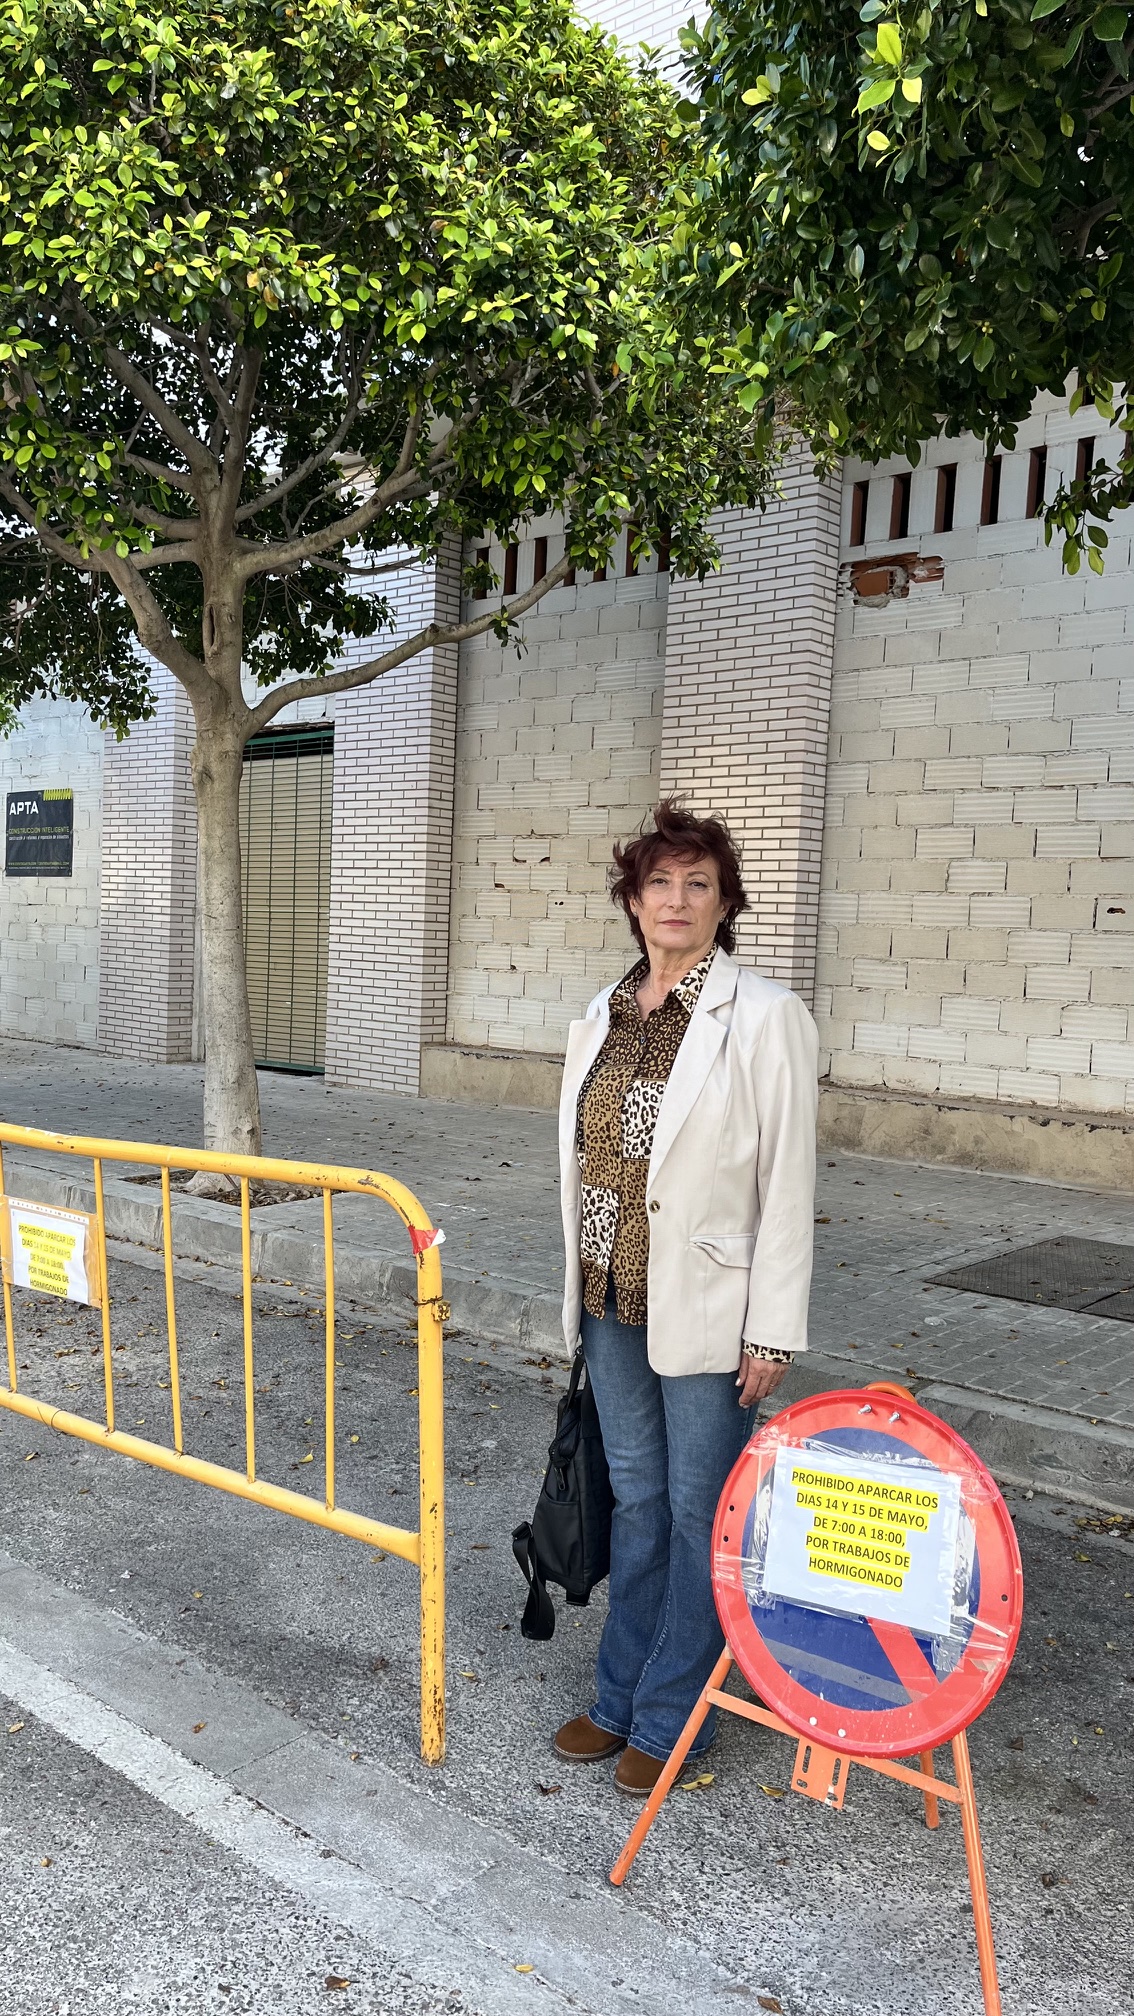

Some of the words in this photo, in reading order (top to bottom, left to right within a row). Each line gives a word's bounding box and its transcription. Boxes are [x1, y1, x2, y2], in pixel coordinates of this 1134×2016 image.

[9, 801, 39, 815] APTA
[18, 1224, 44, 1237] PROHIBIDO
[45, 1231, 66, 1243] APARCAR
[66, 1237, 76, 1247] LOS
[21, 1238, 33, 1247] DIAS
[43, 1244, 49, 1252] 15
[49, 1245, 55, 1254] DE
[30, 1252, 36, 1261] DE
[36, 1254, 46, 1265] 7:00
[28, 1265, 37, 1275] POR
[37, 1268, 61, 1282] TRABAJOS
[62, 1275, 70, 1284] DE
[29, 1278, 68, 1296] HORMIGONADO
[791, 1471, 854, 1492] PROHIBIDO
[857, 1483, 912, 1504] APARCAR
[915, 1494, 938, 1509] LOS
[796, 1492, 822, 1507] DIAS
[825, 1498, 838, 1510] 14
[841, 1501, 849, 1512] Y
[852, 1503, 865, 1516] 15
[868, 1507, 884, 1520] DE
[887, 1510, 928, 1530] MAYO,
[813, 1516, 828, 1529] DE
[831, 1519, 856, 1535] 7:00
[858, 1526, 867, 1537] A
[870, 1528, 905, 1547] 18:00,
[805, 1535, 829, 1550] POR
[832, 1540, 891, 1564] TRABAJOS
[894, 1554, 910, 1568] DE
[808, 1556, 903, 1588] HORMIGONADO
